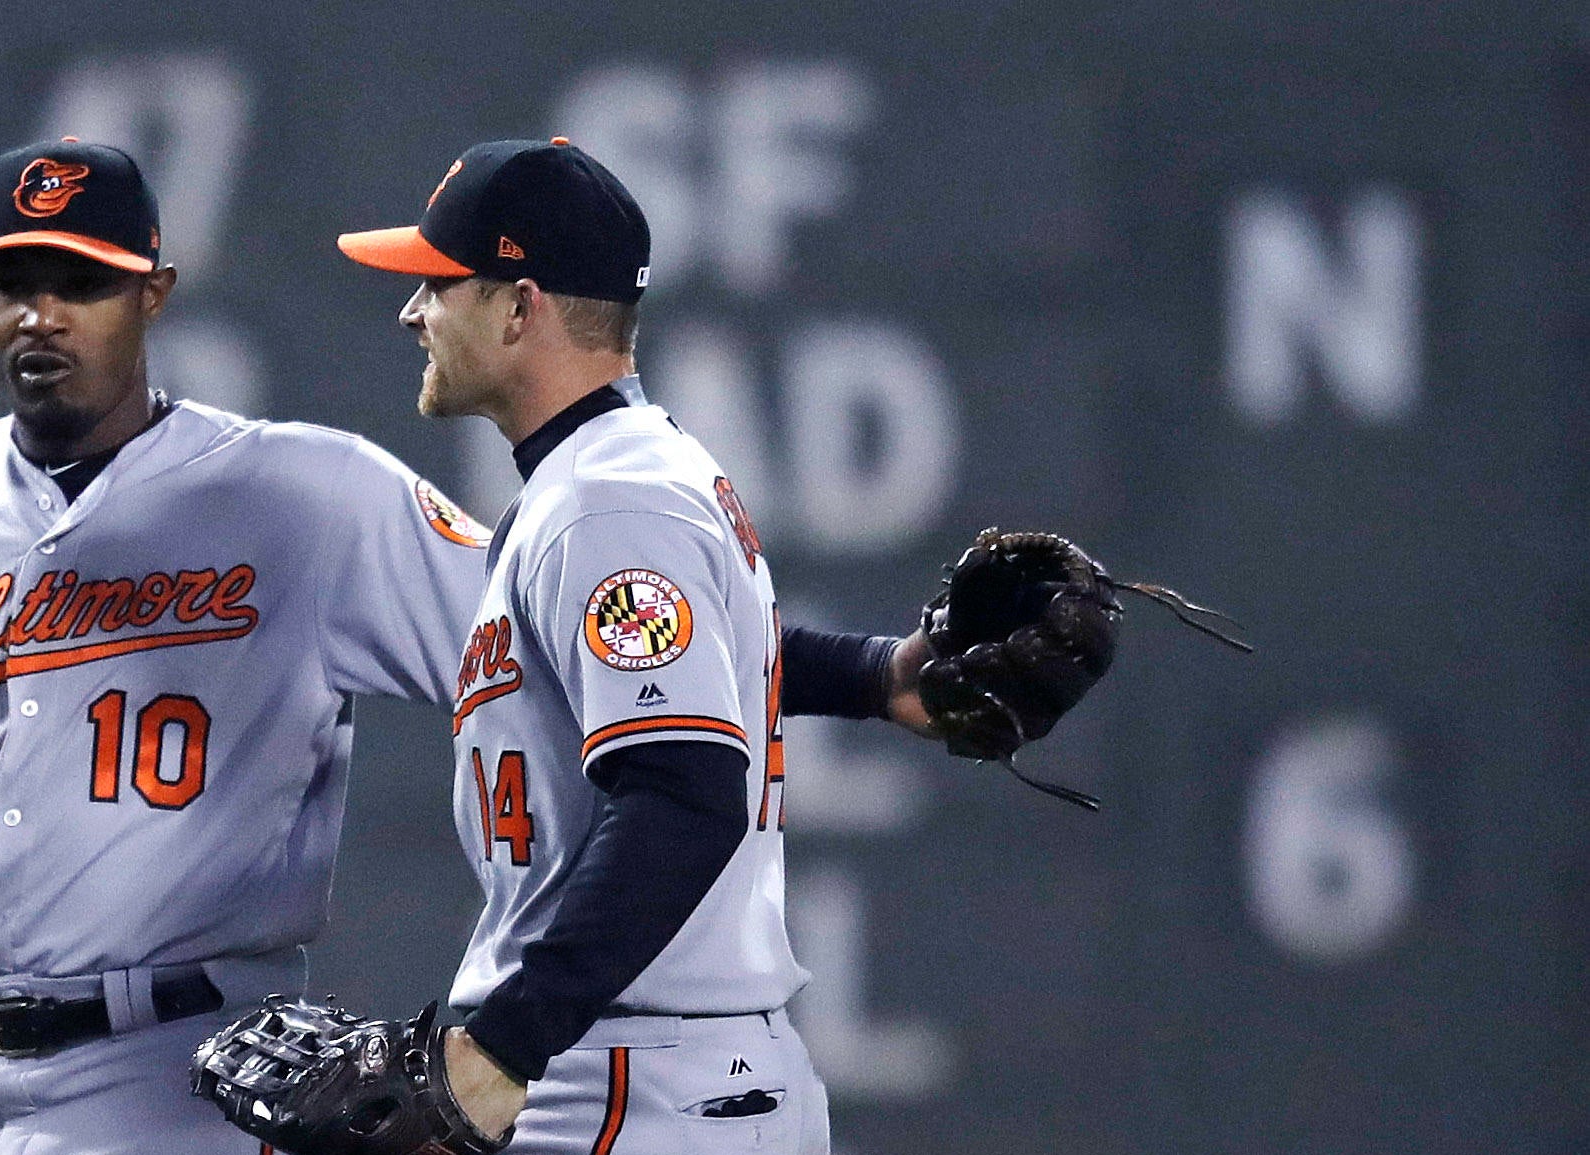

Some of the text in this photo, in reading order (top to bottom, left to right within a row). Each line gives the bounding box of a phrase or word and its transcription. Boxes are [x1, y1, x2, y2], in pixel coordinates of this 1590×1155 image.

[1225, 190, 1422, 426] N
[588, 570, 684, 615] BALTIMORE
[605, 644, 683, 668] ORIOLES
[88, 689, 211, 810] 10
[471, 747, 534, 867] 14
[1247, 712, 1412, 962] 6
